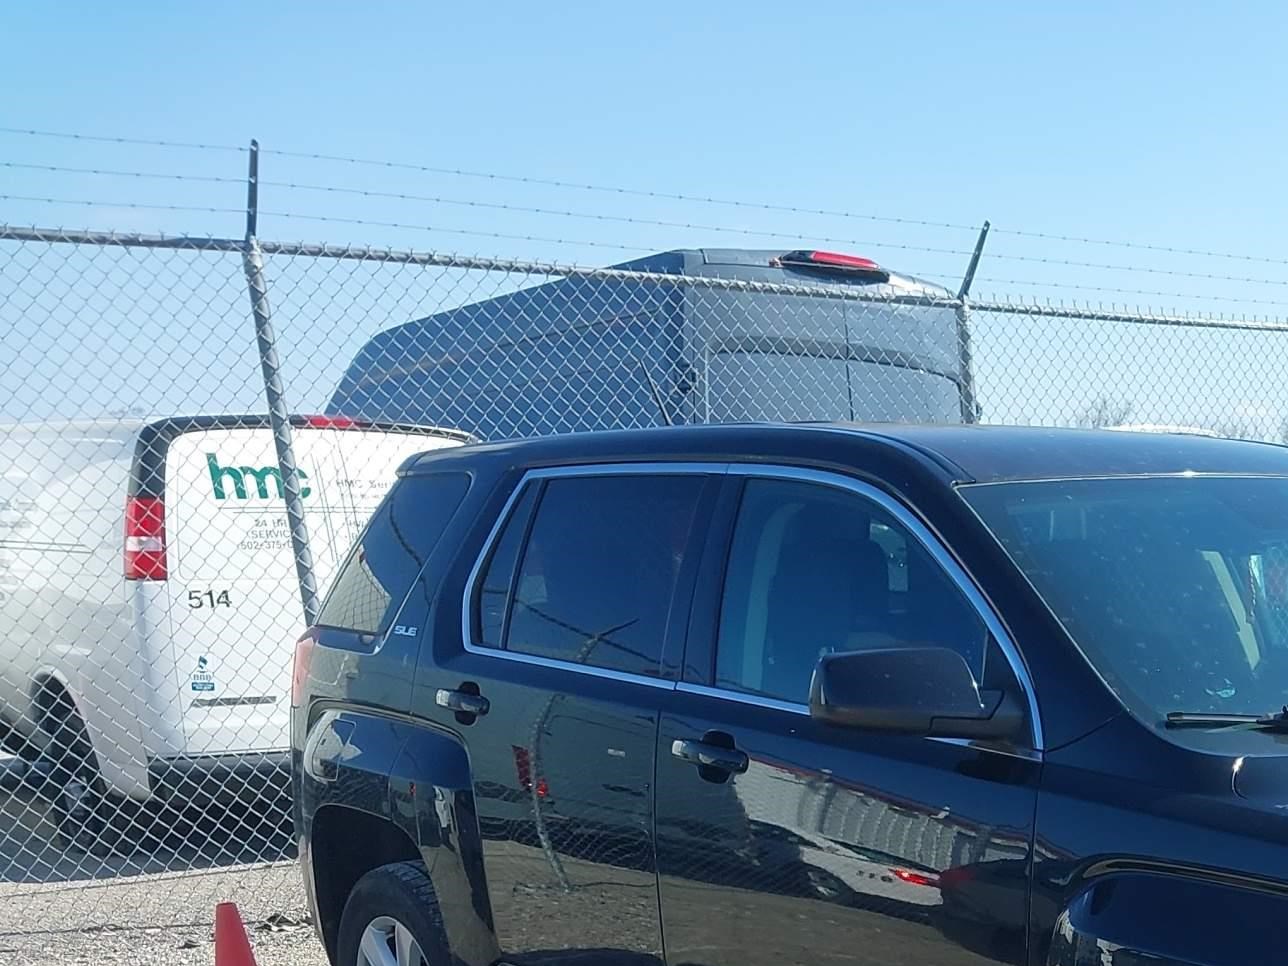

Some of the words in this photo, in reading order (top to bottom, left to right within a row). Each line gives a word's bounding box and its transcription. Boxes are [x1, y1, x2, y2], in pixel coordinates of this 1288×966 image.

[251, 529, 291, 540] SERVIC
[188, 590, 232, 609] 514
[393, 625, 418, 637] SLE
